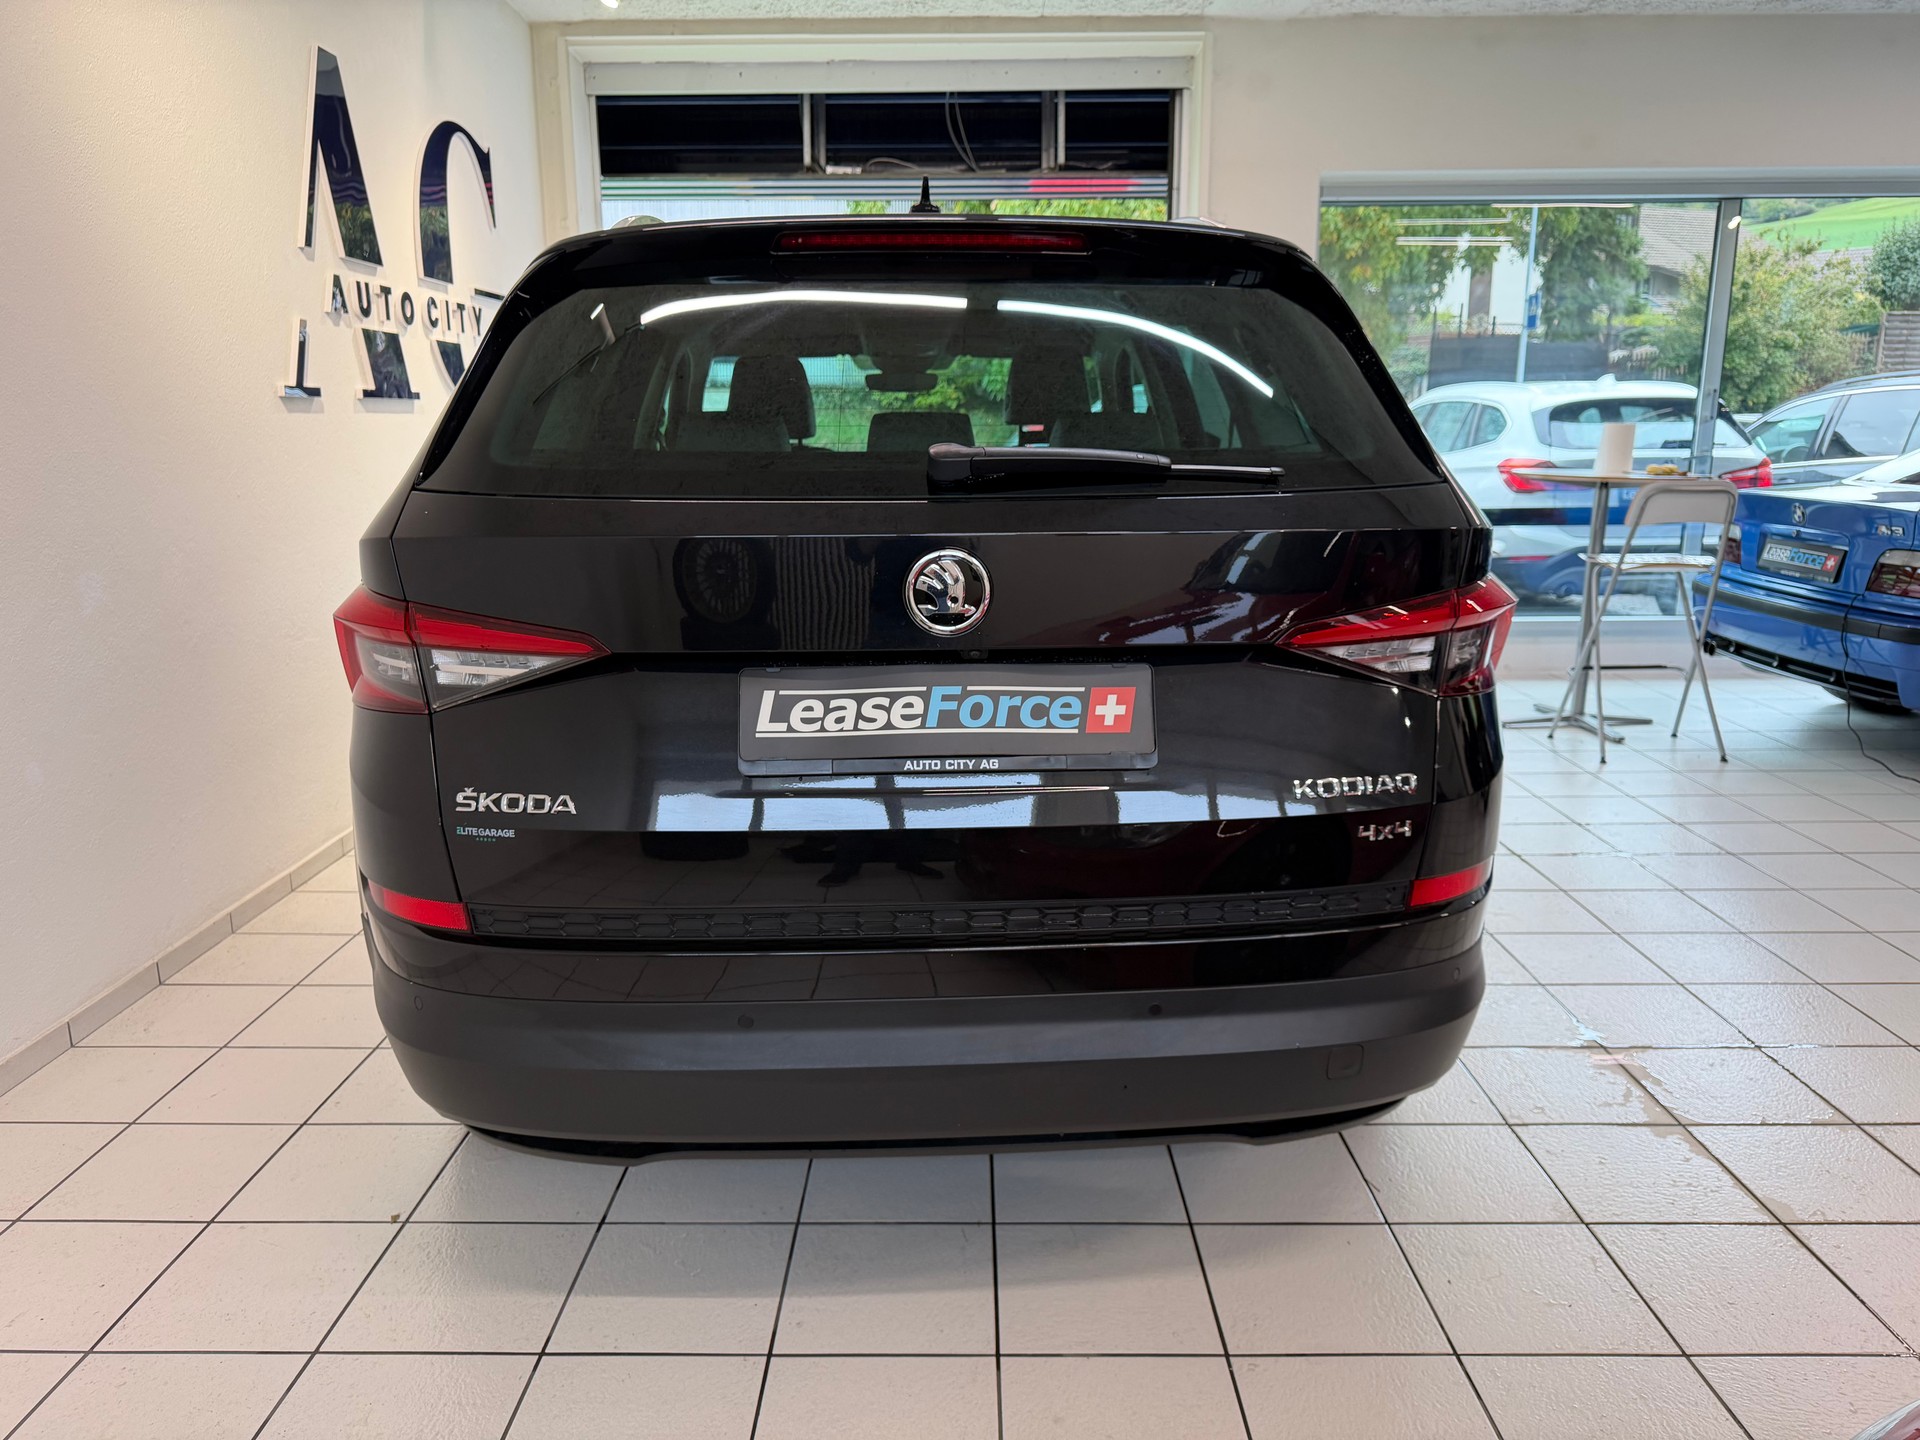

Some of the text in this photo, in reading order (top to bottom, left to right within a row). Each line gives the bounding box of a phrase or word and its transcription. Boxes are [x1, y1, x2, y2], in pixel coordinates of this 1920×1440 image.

[333, 274, 482, 337] AUTO CITY
[1762, 543, 1825, 567] LeaseForce
[755, 686, 1082, 732] LeaseForce
[904, 759, 999, 771] AUTO CITY AG
[1293, 773, 1418, 799] KODIAQ
[455, 787, 577, 814] ŠKODA
